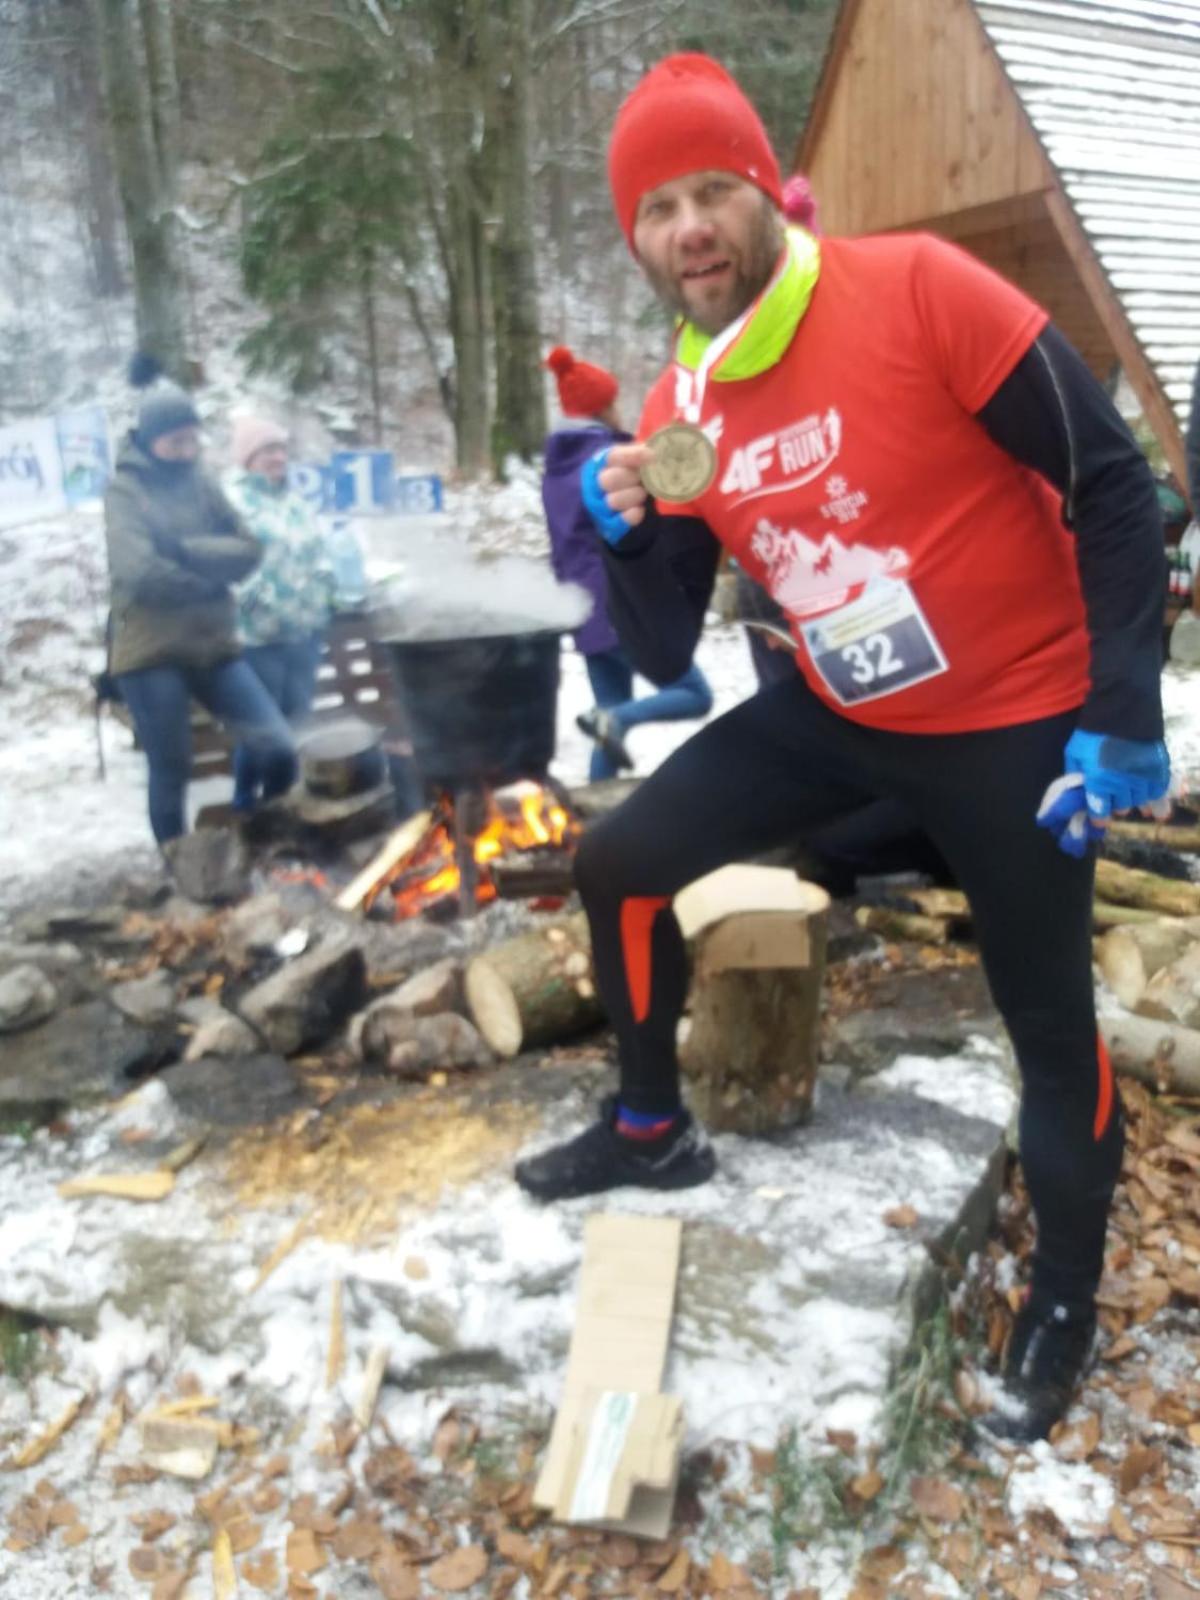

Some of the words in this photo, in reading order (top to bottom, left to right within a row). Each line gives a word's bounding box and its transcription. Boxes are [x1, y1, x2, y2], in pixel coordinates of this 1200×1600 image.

[344, 455, 383, 514] 1
[719, 435, 776, 494] 4F
[779, 427, 827, 475] RUN
[842, 633, 903, 684] 32
